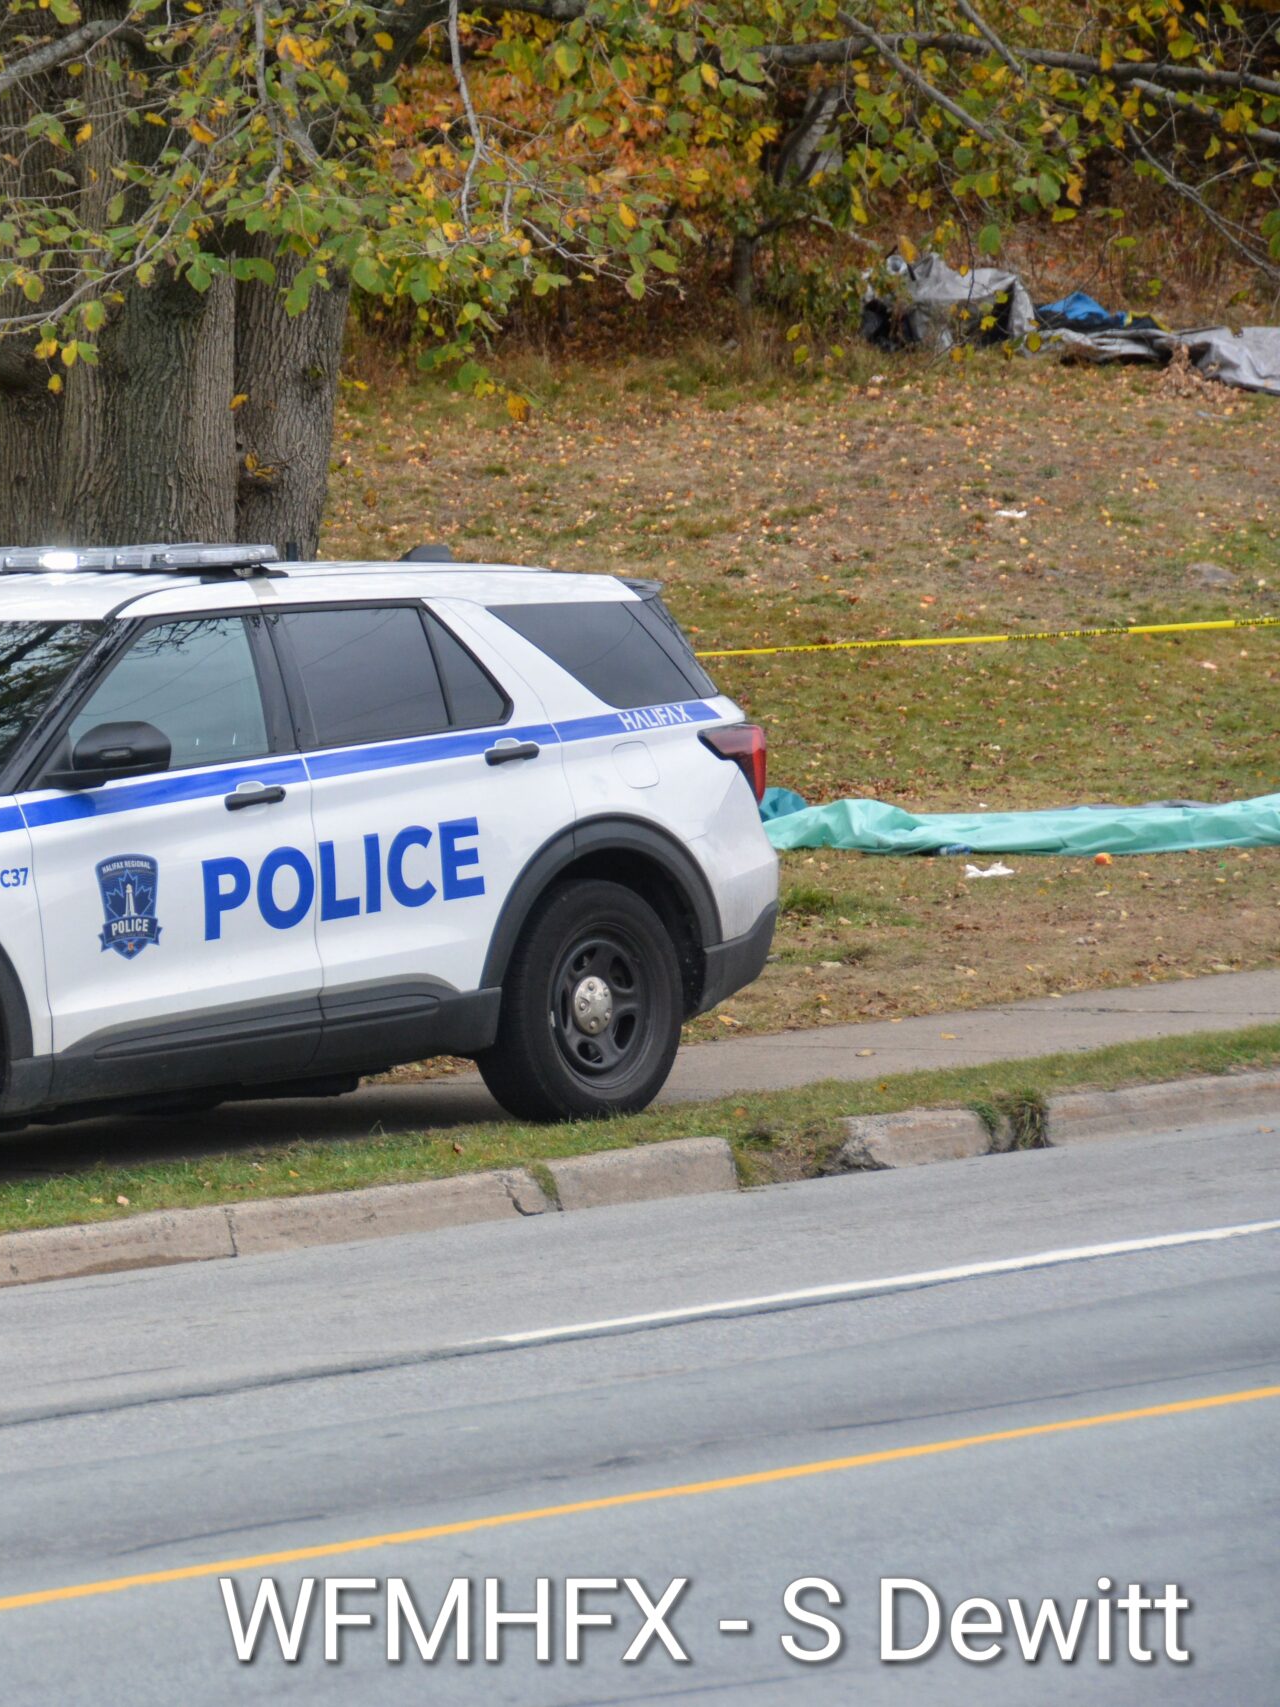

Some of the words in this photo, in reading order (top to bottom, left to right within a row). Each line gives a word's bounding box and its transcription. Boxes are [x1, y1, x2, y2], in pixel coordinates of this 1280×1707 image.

[617, 703, 693, 732] HALIFAX
[0, 866, 30, 889] C37
[101, 861, 124, 874] HALIFAX
[124, 860, 151, 870] REGIONAL
[201, 816, 486, 942] POLICE
[111, 918, 149, 937] POLICE
